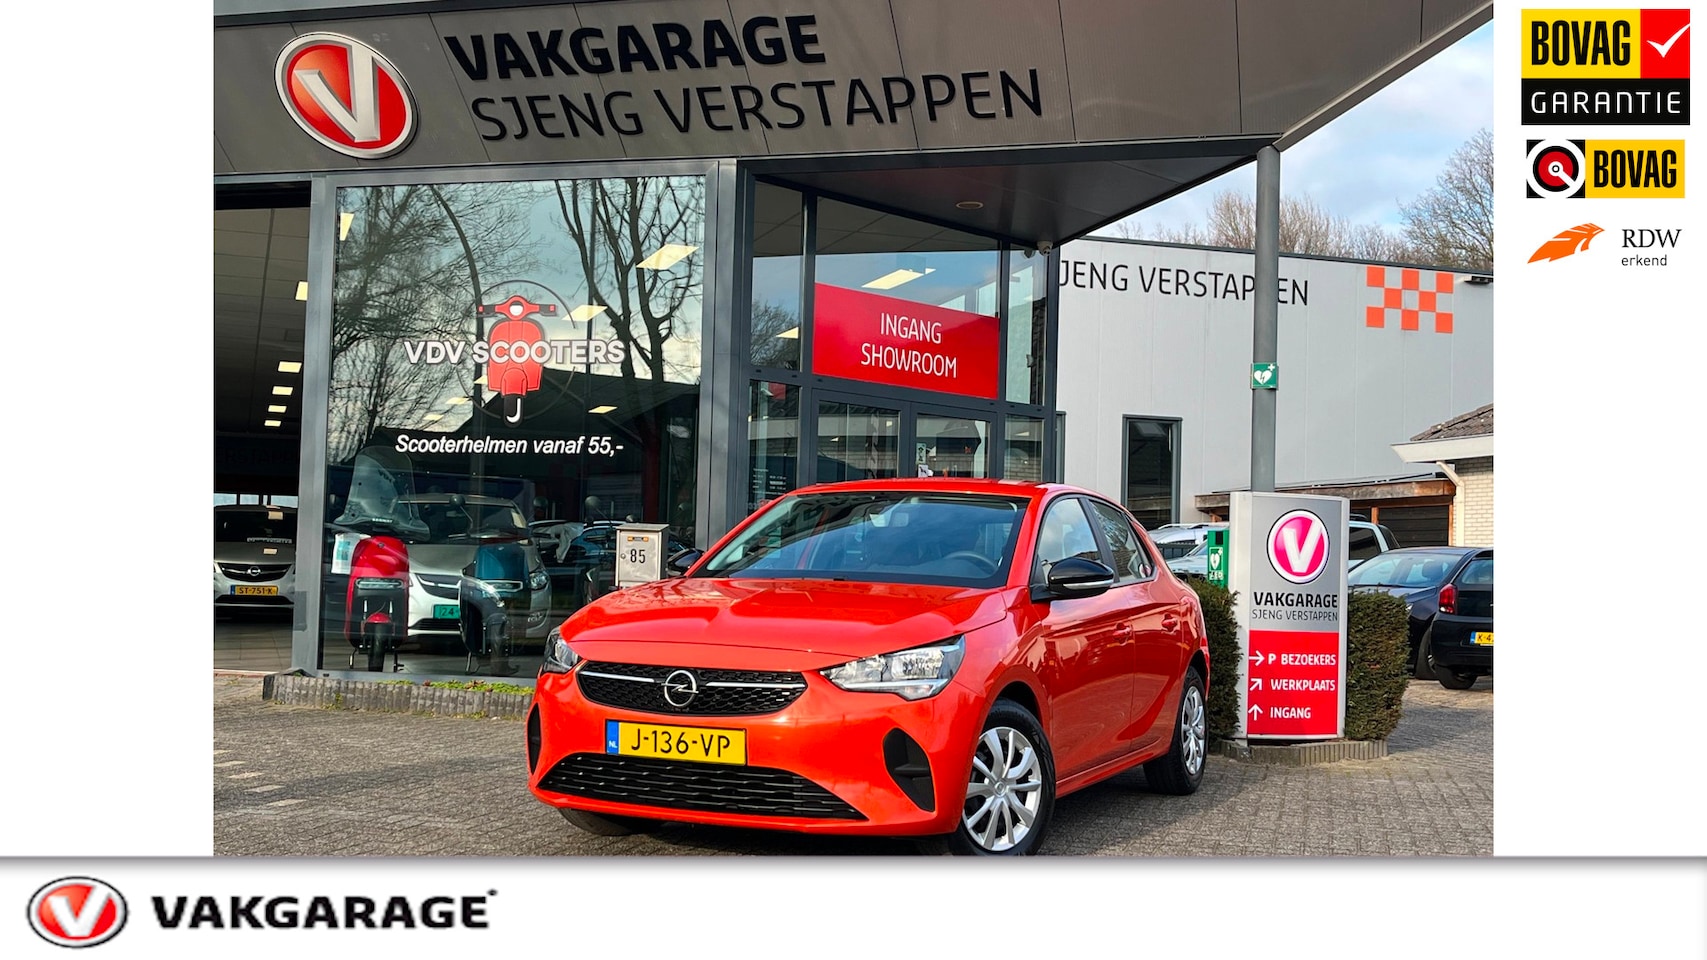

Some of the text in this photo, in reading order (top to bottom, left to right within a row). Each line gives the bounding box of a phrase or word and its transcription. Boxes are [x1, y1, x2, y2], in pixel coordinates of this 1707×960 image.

[444, 14, 826, 81] VAKGARAGE
[471, 69, 1043, 142] SJENG VERSTAPPEN
[1059, 260, 1309, 307] JENG VERSTAPEN
[880, 312, 942, 345] INGANG
[403, 339, 627, 365] VDV SCOOTERS
[860, 342, 958, 379] SHOWROOM
[395, 434, 624, 457] Scooterhelmen vanaf 55,-
[630, 548, 646, 564] 85
[1253, 591, 1338, 608] VAKGARAGE
[1252, 609, 1338, 622] SJENG VERSTAPPEN
[1267, 653, 1337, 666] P BEZOEKERS
[1270, 678, 1336, 691] WERKPLAATS
[1270, 706, 1312, 719] INGANG
[631, 728, 731, 758] J-136-VP
